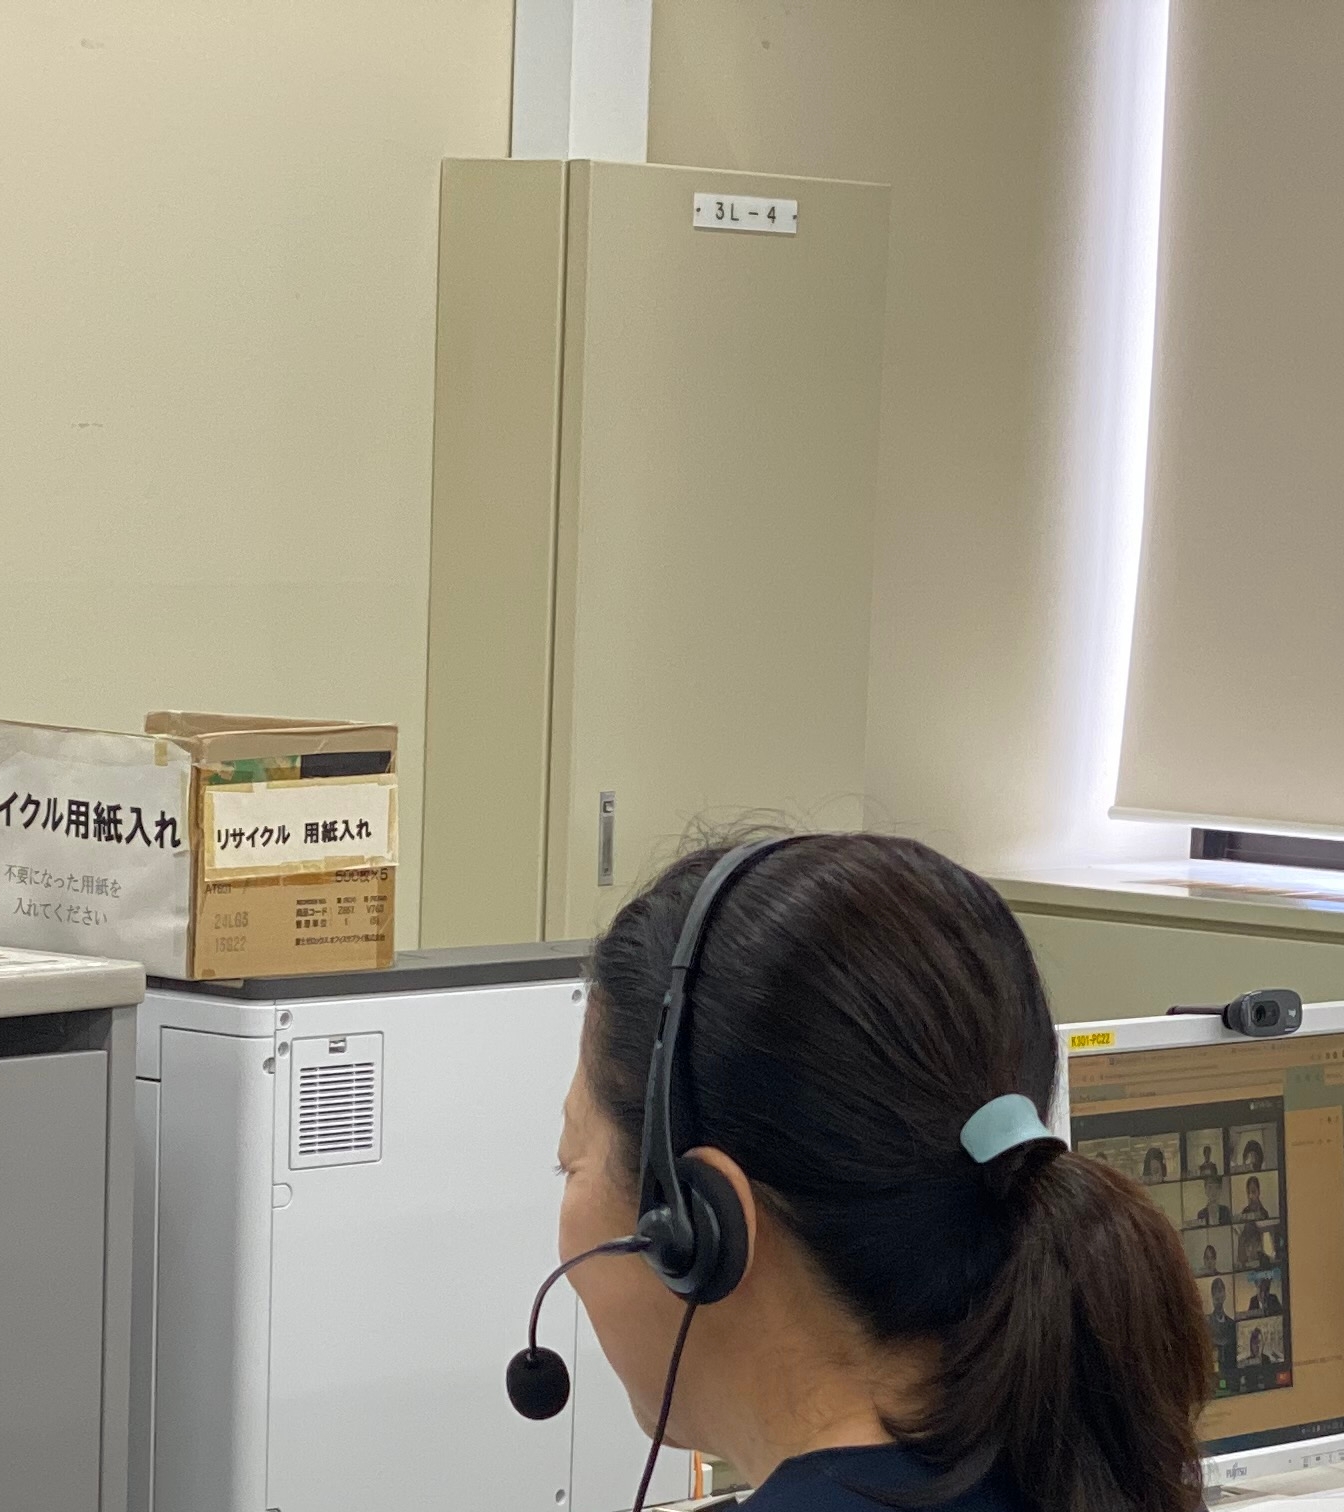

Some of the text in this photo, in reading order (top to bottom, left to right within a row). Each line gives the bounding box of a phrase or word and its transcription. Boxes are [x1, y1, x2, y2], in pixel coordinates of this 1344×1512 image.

[217, 818, 372, 851] リサイクル 用紙入れ
[4, 863, 123, 899] 不要になった用紙を
[12, 897, 108, 926] 入れてください
